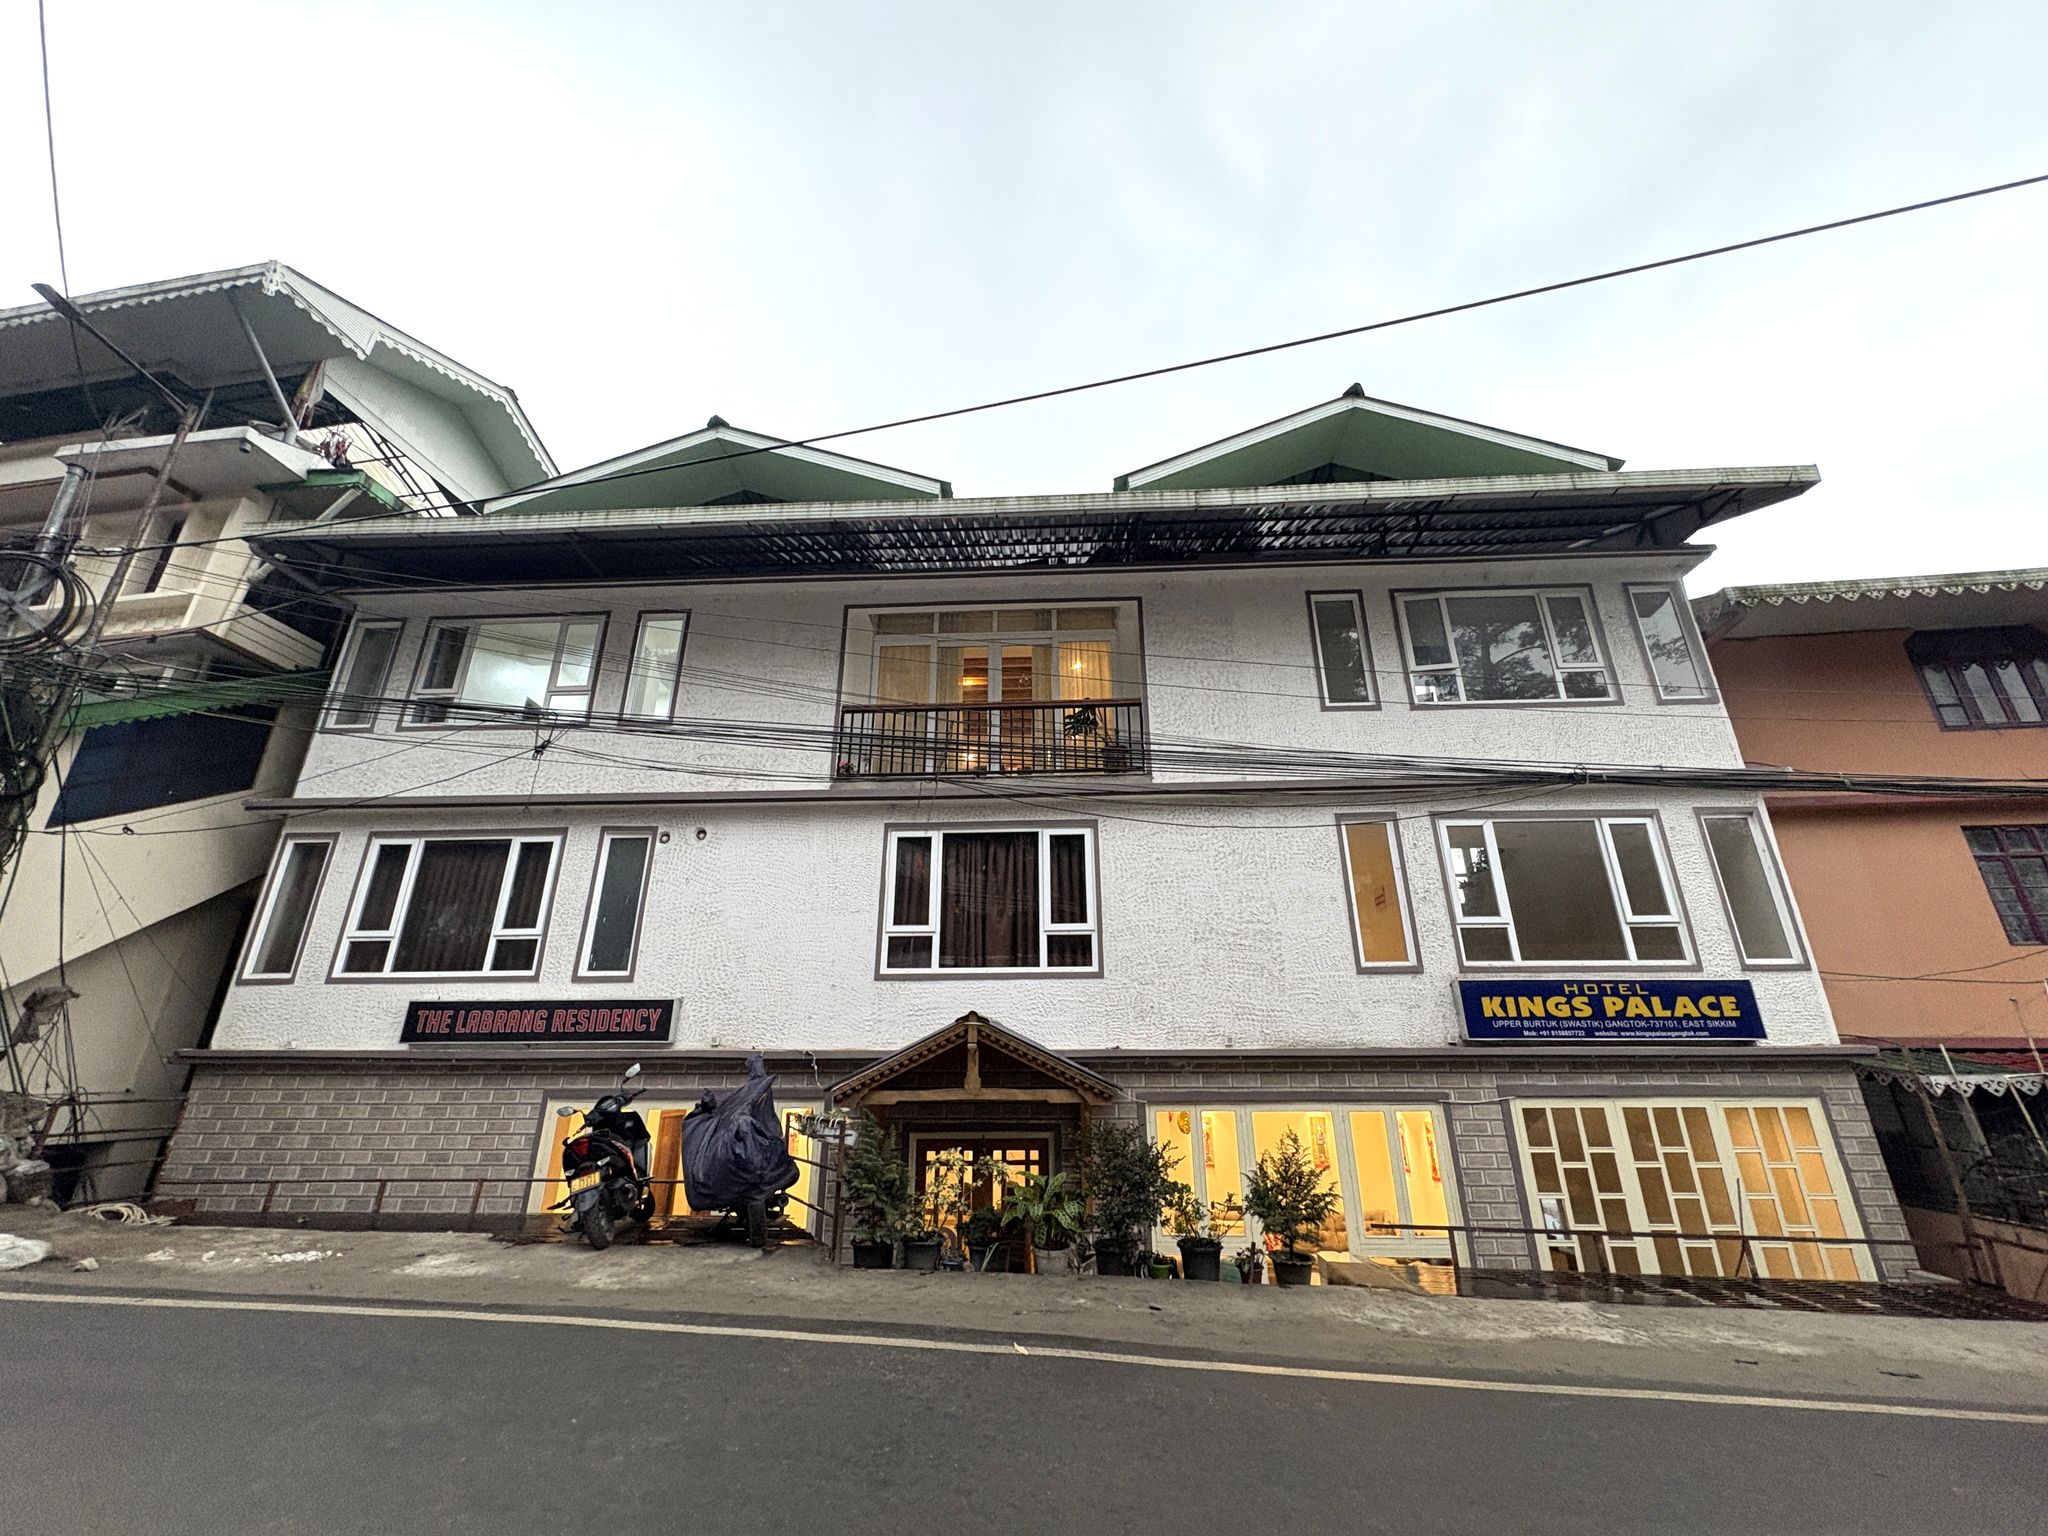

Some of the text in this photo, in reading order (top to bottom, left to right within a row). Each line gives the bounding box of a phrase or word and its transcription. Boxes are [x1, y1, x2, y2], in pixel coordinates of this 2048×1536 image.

[1563, 983, 1650, 995] HOTEL
[1480, 995, 1741, 1018] KINGS PALACE
[416, 1008, 662, 1033] THE LABRANG RESIDENCY
[1492, 1020, 1522, 1028] UPPER
[1523, 1020, 1558, 1028] BURTUK
[1560, 1020, 1604, 1029] (SWASTIK)
[1707, 1020, 1737, 1028] SIKKIM
